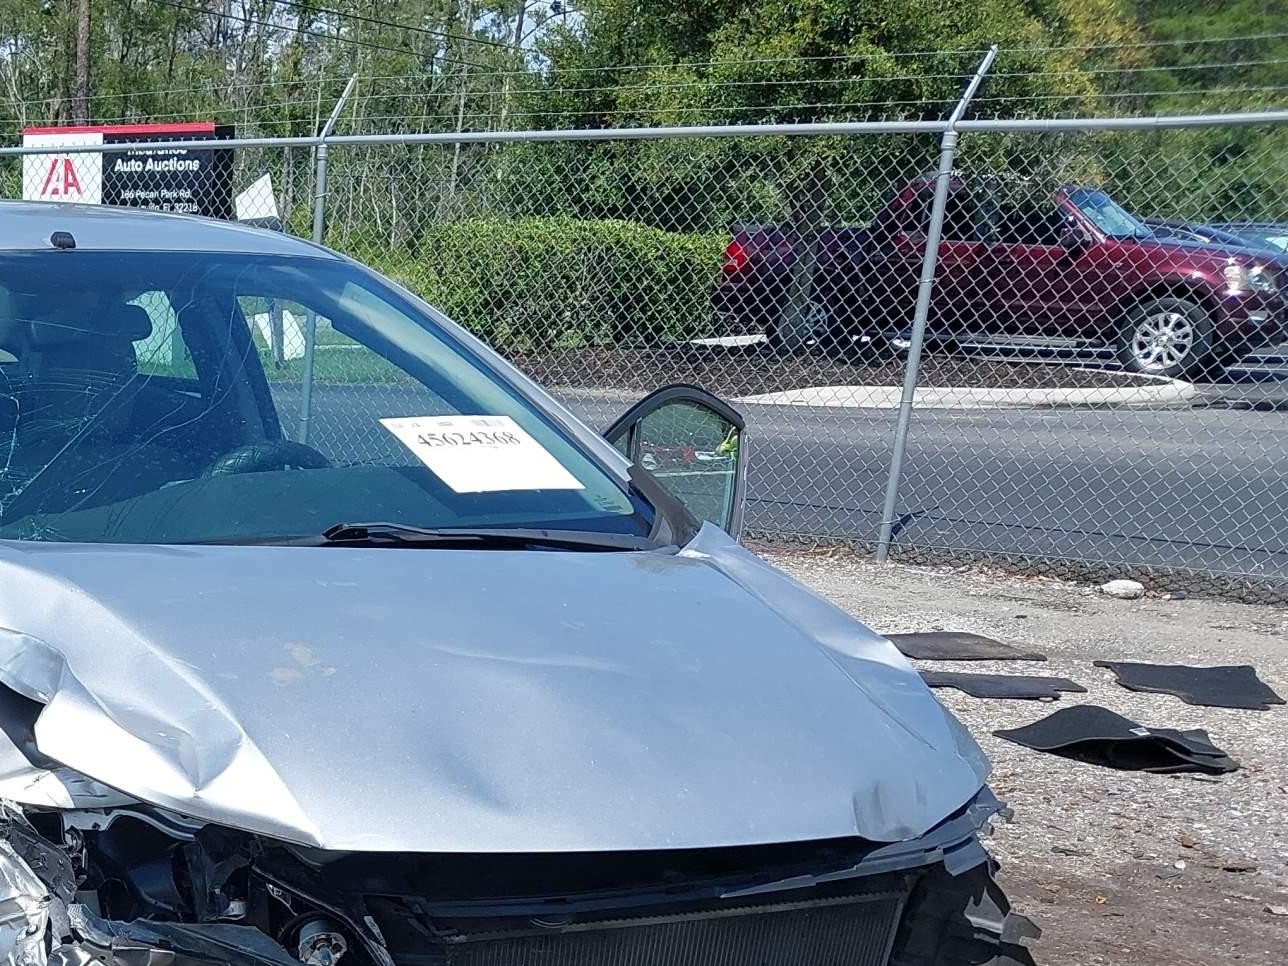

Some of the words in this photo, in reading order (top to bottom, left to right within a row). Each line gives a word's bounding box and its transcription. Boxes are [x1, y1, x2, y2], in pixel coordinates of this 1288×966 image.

[114, 157, 144, 172] Auto
[144, 156, 200, 172] Auctions
[135, 188, 159, 199] Pecan
[160, 188, 178, 199] Park
[417, 431, 521, 447] 45624368
